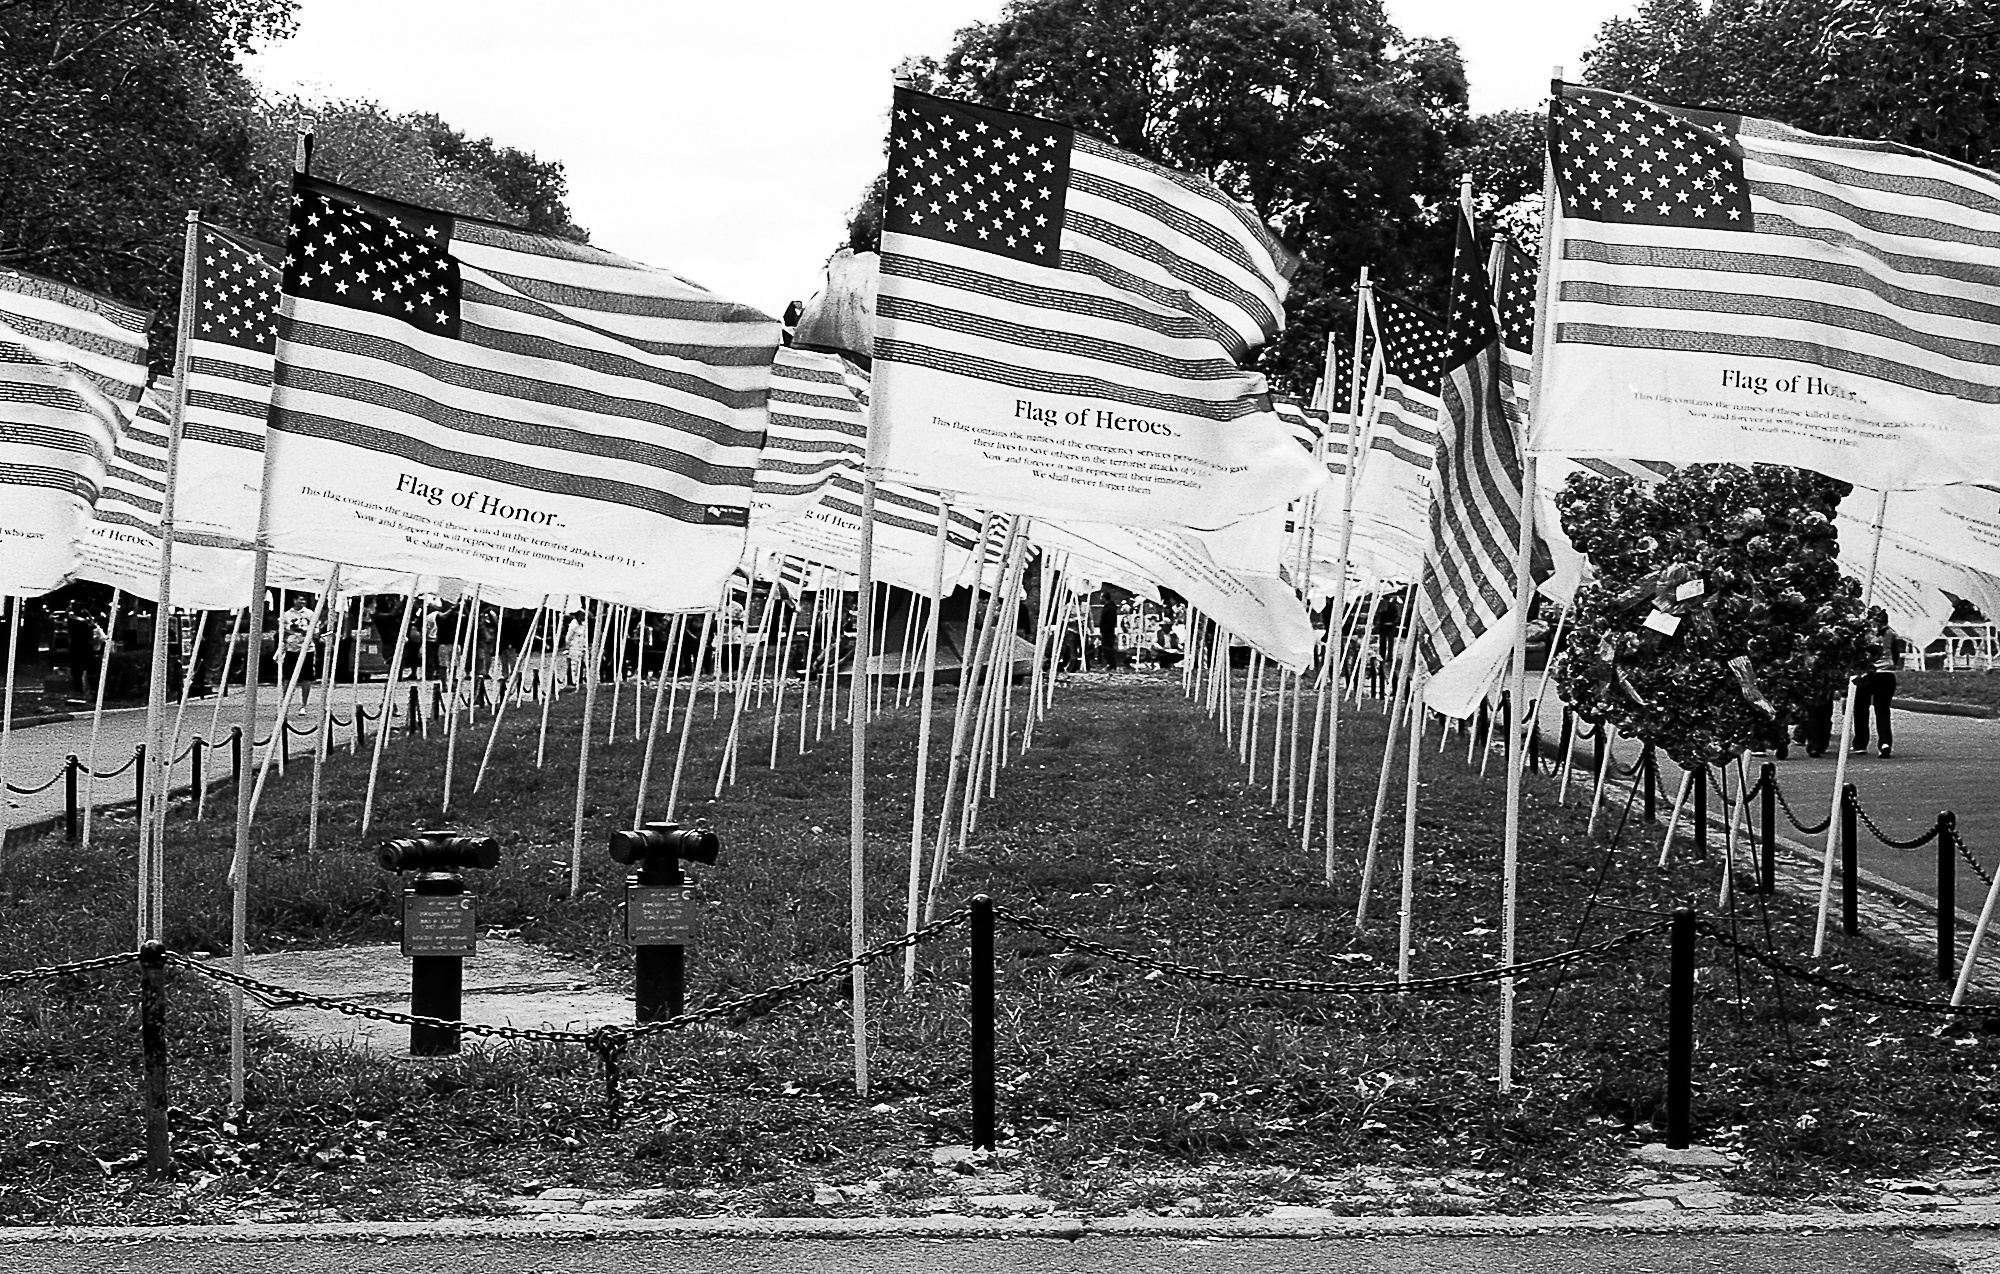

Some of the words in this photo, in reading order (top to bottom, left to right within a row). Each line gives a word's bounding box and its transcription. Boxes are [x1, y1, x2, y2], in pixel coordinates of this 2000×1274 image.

[1722, 369, 1768, 395] Flag
[1775, 375, 1802, 393] of
[1014, 399, 1057, 427] Flag
[1065, 408, 1091, 427] of
[932, 416, 951, 427] This
[952, 421, 970, 432] flag
[972, 427, 1008, 438] contains
[1010, 431, 1023, 440] the
[1026, 434, 1054, 444] names
[1056, 438, 1066, 447] of
[1068, 440, 1082, 449] the
[1085, 443, 1134, 456] emergency
[973, 438, 994, 449] their
[996, 441, 1016, 451] lives
[1018, 444, 1028, 452] to
[1030, 448, 1049, 456] save
[1050, 450, 1079, 461] others
[1081, 454, 1091, 462] in
[1093, 455, 1107, 465] the
[1110, 458, 1147, 469] terrorist
[1149, 462, 1179, 473] attacks
[982, 451, 1001, 461] Now
[1005, 455, 1021, 464] and
[1024, 457, 1054, 468] forever
[1066, 463, 1084, 473] will
[1086, 466, 1128, 480] represent
[1131, 470, 1153, 482] their
[396, 473, 445, 506] Flag
[451, 491, 479, 510] of
[1032, 469, 1046, 479] We
[1049, 472, 1069, 482] shall
[1071, 476, 1097, 488] never
[1098, 479, 1125, 491] forget
[91, 527, 106, 537] of
[301, 486, 321, 498] This
[323, 489, 341, 502] flag
[343, 496, 383, 512] contains
[385, 505, 401, 515] the
[402, 511, 431, 524] names
[433, 519, 445, 528] of
[502, 530, 512, 540] in
[513, 532, 529, 544] the
[531, 536, 568, 552] terrorist
[570, 547, 603, 559] attacks
[604, 553, 615, 562] of
[354, 510, 377, 522] Now
[378, 519, 397, 528] and
[398, 522, 430, 536] forever
[443, 531, 461, 542] will
[463, 536, 506, 551] represent
[508, 544, 530, 557] their
[816, 513, 831, 523] of
[832, 515, 861, 531] Hero
[405, 535, 419, 546] We
[421, 539, 444, 551] shall
[472, 549, 500, 564] forget
[502, 556, 527, 569] them
